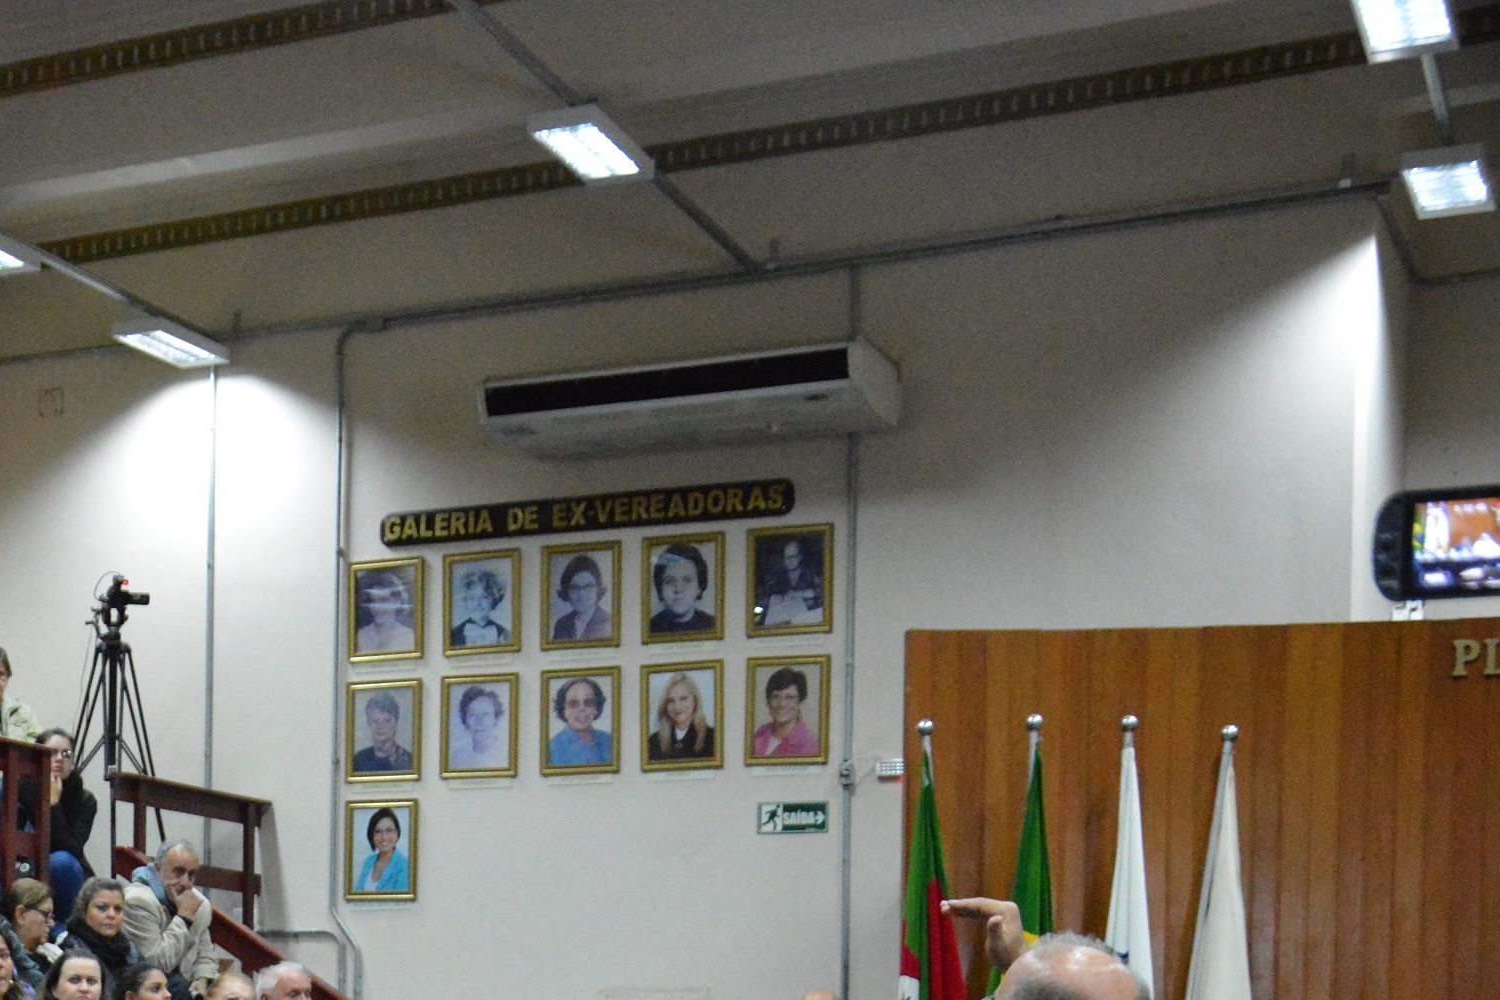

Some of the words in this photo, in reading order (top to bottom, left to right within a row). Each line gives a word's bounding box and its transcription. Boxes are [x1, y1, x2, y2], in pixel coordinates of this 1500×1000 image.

[384, 509, 493, 541] GALERIA
[507, 505, 539, 533] DE
[783, 809, 816, 825] SAÍDA
